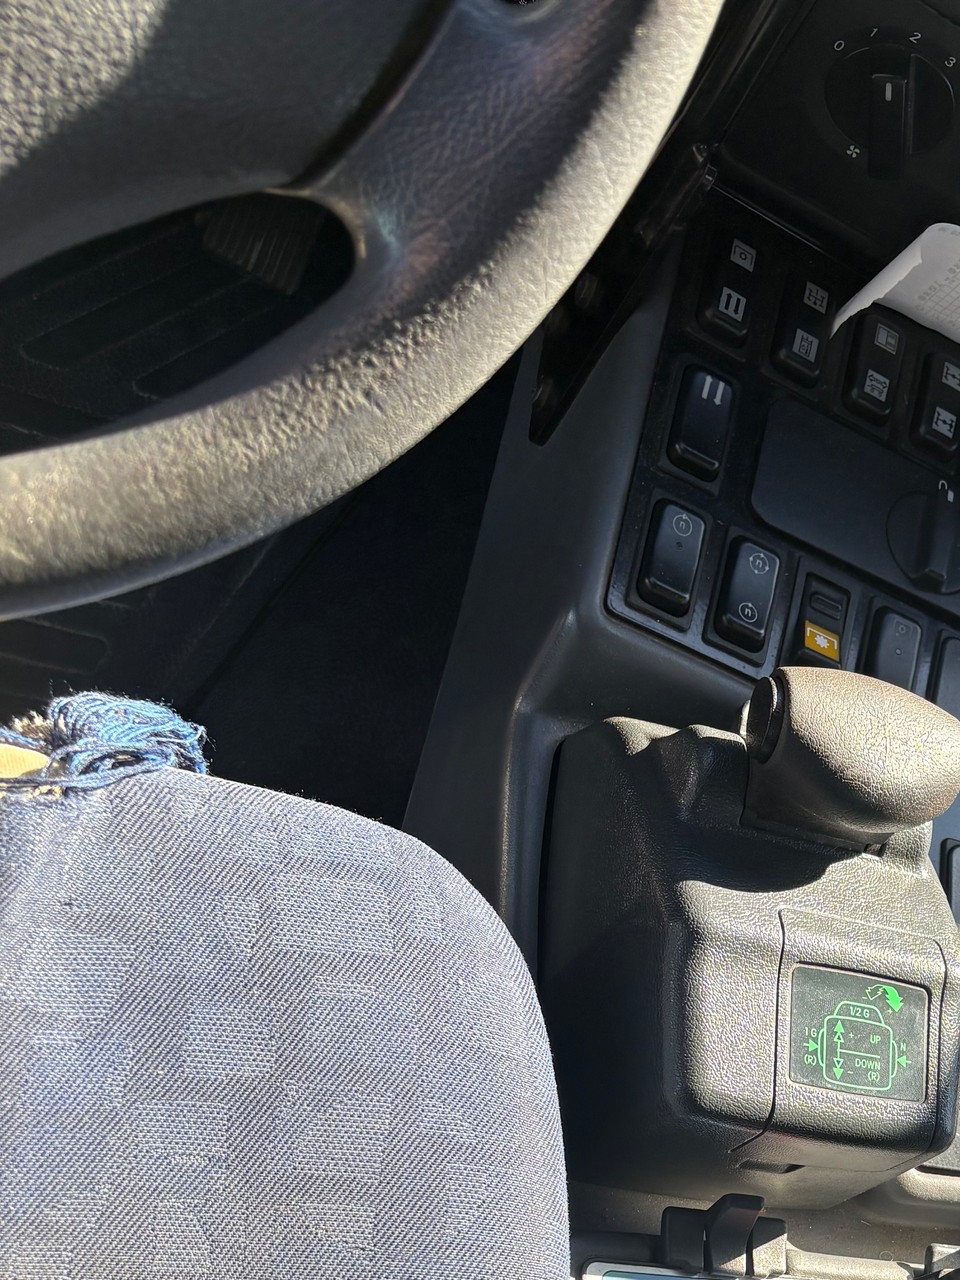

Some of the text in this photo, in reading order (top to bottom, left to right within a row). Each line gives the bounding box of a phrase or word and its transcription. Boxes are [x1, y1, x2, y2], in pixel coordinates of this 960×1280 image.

[833, 40, 845, 51] 0
[870, 27, 878, 38] 1
[909, 32, 922, 44] 2
[944, 56, 956, 67] 3
[863, 1009, 870, 1018] G
[811, 1028, 817, 1037] G
[870, 1034, 881, 1044] UP
[900, 1042, 906, 1052] N
[804, 1054, 817, 1066] (R)
[855, 1058, 880, 1070] DOWN
[867, 1071, 880, 1082] (R)
